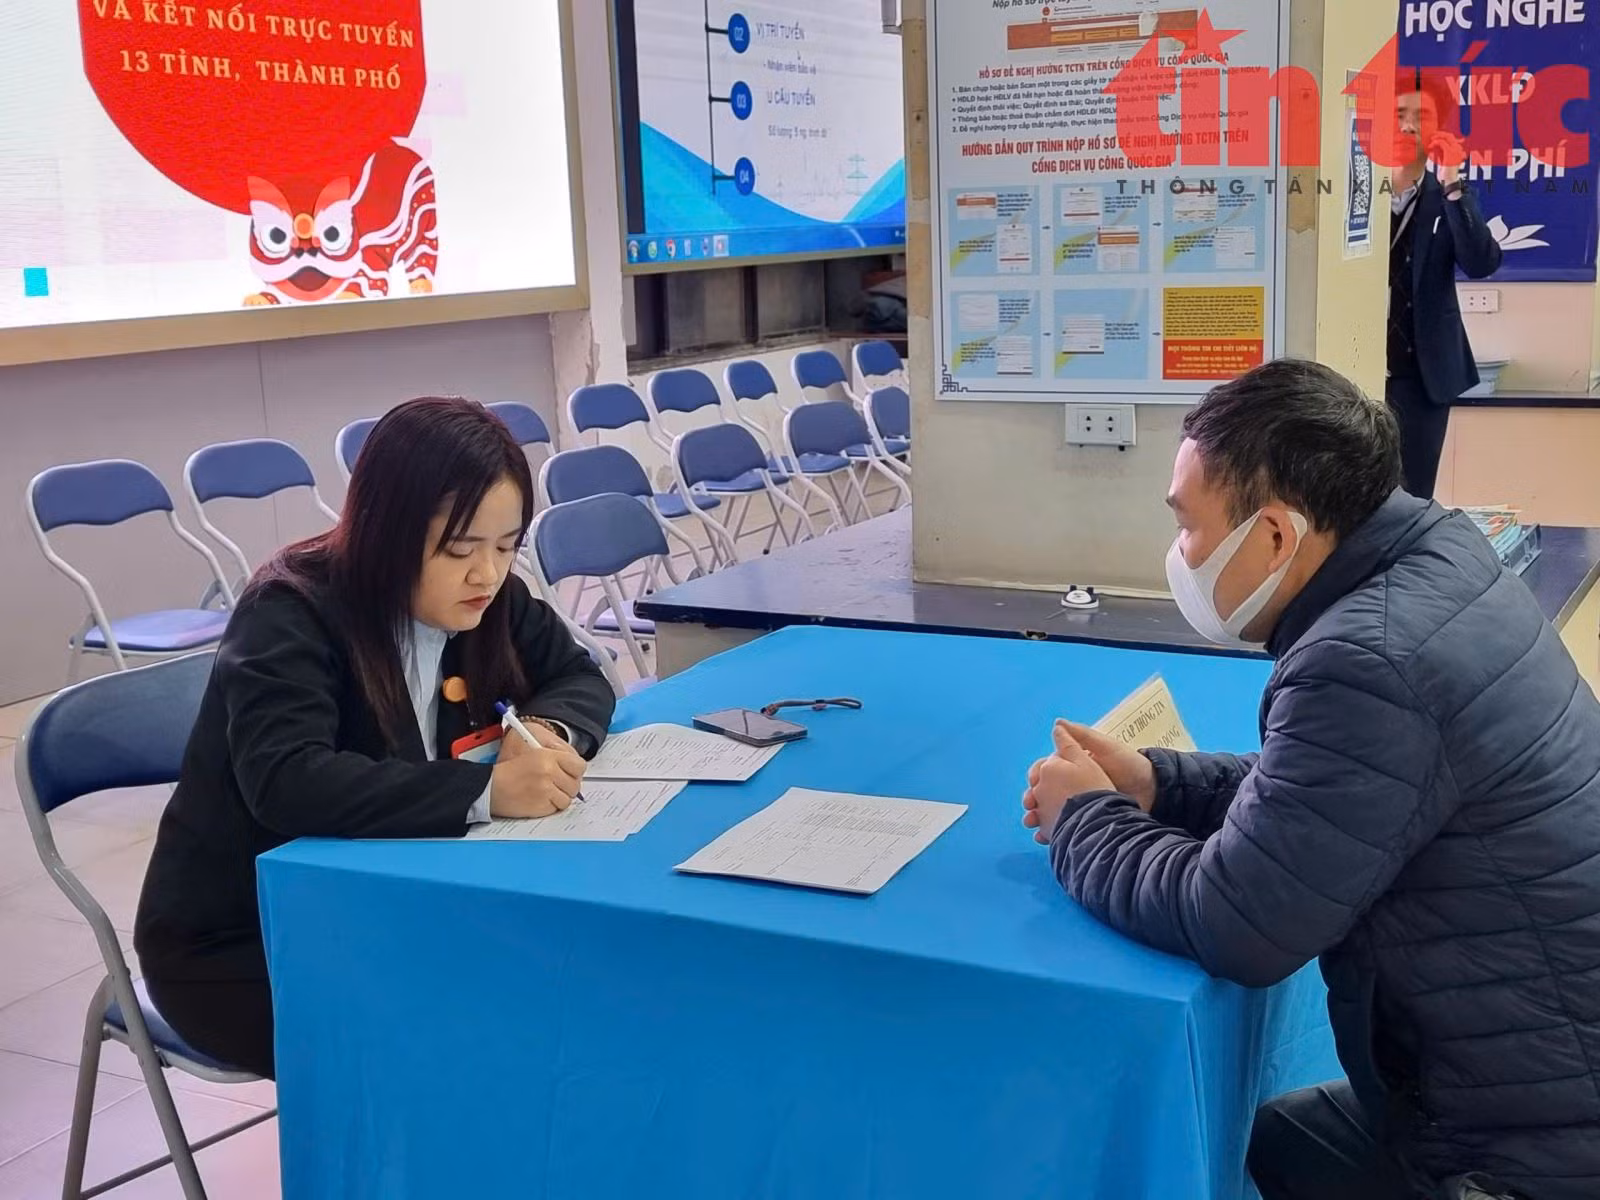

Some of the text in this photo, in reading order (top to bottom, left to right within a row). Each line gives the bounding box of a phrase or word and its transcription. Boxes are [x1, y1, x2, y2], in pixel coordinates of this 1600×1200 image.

[206, 3, 257, 33] NỐI
[265, 14, 333, 43] TRỰC
[1404, 1, 1473, 42] HỌC
[734, 26, 744, 41] 02
[119, 48, 401, 90] 13 TỈNH, THÀNH PHỐ
[1064, 62, 1085, 73] TCTN
[736, 93, 747, 109] 03
[1016, 141, 1034, 155] QUY
[1036, 138, 1064, 153] TRÌNH
[1065, 136, 1085, 154] NỘP
[1059, 159, 1081, 175] DỊCH
[1083, 158, 1095, 174] VỤ
[1098, 155, 1125, 170] CÔNG
[1506, 139, 1568, 183] PHÍ
[739, 169, 750, 182] 04
